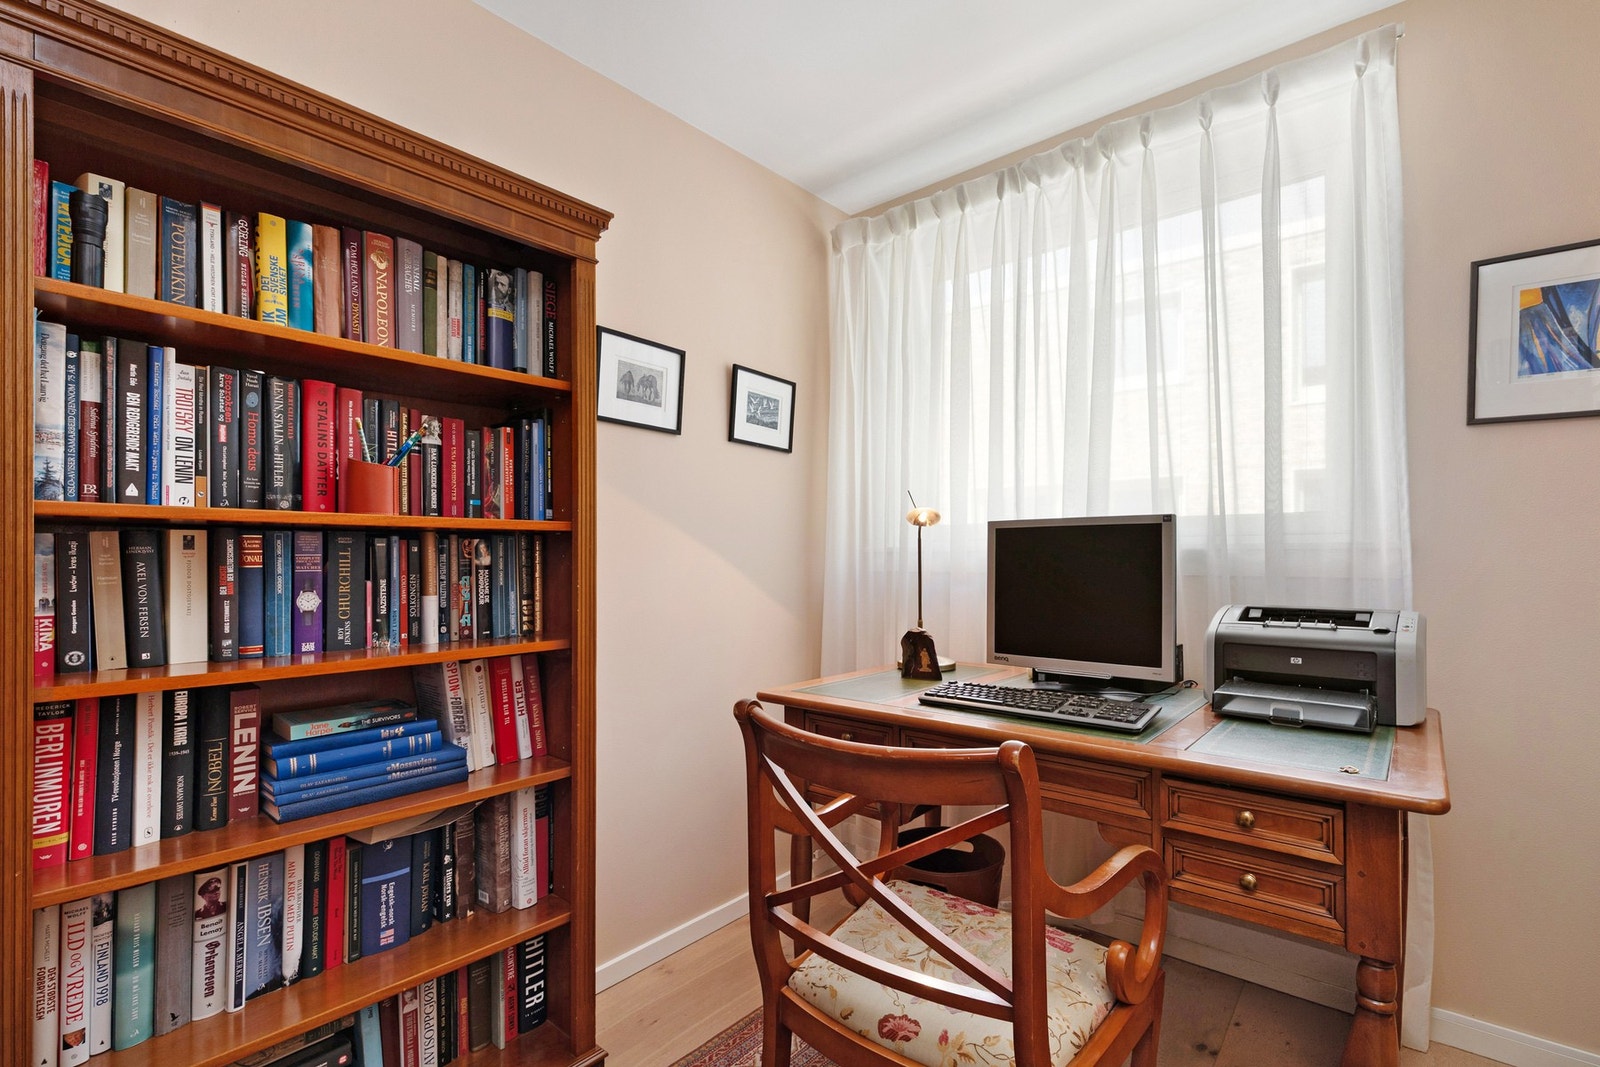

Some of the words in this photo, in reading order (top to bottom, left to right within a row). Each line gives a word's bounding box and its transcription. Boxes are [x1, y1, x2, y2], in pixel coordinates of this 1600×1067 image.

[171, 223, 186, 304] POTEMKIN
[350, 242, 358, 258] TOM
[261, 275, 270, 292] DET
[269, 254, 280, 294] SVENSKE
[278, 262, 288, 296] SVIKET
[351, 259, 359, 297] HOLLAND
[376, 270, 389, 347] NAPOLEON
[546, 281, 557, 319] SIEGE
[352, 303, 360, 335] DYNASTI
[39, 333, 50, 359] Dengang
[40, 360, 50, 369] det
[40, 370, 50, 379] het
[129, 363, 138, 376] Martin
[548, 351, 556, 374] WOLFF
[39, 380, 50, 403] Laurvig
[68, 384, 77, 416] GJENNOM
[125, 392, 140, 407] DEN
[225, 373, 233, 423] Storoksen
[272, 381, 284, 412] LENIN,
[89, 407, 98, 430] Sabina
[174, 387, 194, 434] TROTSKY
[217, 414, 225, 422] og
[316, 400, 328, 448] STALINS
[68, 416, 77, 452] SAMARBEID
[125, 407, 140, 452] REDIGERENDE
[174, 436, 194, 451] ON
[247, 411, 260, 446] Homo
[273, 412, 284, 446] STALIN
[86, 431, 98, 458] Spielrein
[247, 447, 261, 471] deus
[125, 452, 140, 472] MAKT
[174, 454, 194, 484] LENIN
[273, 453, 284, 487] HITLER
[316, 451, 328, 497] DATTER
[136, 561, 147, 582] AXEL
[338, 547, 351, 619] CHURCHILL
[137, 584, 148, 604] VON
[409, 574, 417, 618] SOLKONGEN
[484, 595, 490, 603] DE
[39, 618, 53, 652] KINA
[139, 606, 150, 638] FERSEN
[344, 620, 352, 645] JENKINS
[446, 662, 460, 692] SPION
[147, 695, 155, 717] Herbert
[173, 690, 188, 721] EUROPA
[477, 675, 487, 715] Lemberg
[515, 680, 525, 716] HITLER
[147, 717, 155, 739] Pundik
[309, 721, 329, 731] Jane
[361, 718, 370, 726] THE
[370, 713, 401, 725] SURVIVORS
[450, 697, 466, 734] FORRÆDER
[173, 726, 187, 747] KRIG
[305, 727, 334, 737] Harper
[207, 742, 222, 793] NOBEL
[233, 712, 257, 793] LENIN
[33, 722, 65, 835] BERLINMUREN
[176, 775, 184, 801] NORMAN
[175, 802, 184, 820] DAVIES
[257, 863, 270, 902] HENRIK
[287, 861, 296, 879] MIN
[422, 862, 430, 883] KARL
[445, 868, 453, 894] Hitlers
[287, 881, 296, 902] KRIG
[379, 884, 387, 929] Norsk-engelsk
[387, 881, 395, 926] Engelsk-norsk
[421, 884, 429, 912] JOHAN
[63, 906, 89, 915] MICHAEL
[67, 911, 86, 919] WOLFF
[256, 903, 272, 948] IBSEN
[286, 904, 295, 923] MED
[66, 920, 86, 951] ILD
[236, 921, 245, 952] ANGELA
[286, 925, 295, 952] PUTIN
[43, 940, 51, 962] MICHELET
[70, 952, 82, 969] OG
[96, 941, 109, 983] FINLAND
[47, 966, 57, 983] DEN
[235, 953, 243, 985] MERKEL
[525, 937, 545, 1009] HITLER
[35, 966, 46, 1021] FORBRYTELSEN
[46, 983, 56, 1015] STØRSTE
[65, 967, 85, 1026] VREDE
[95, 985, 109, 1007] 1918
